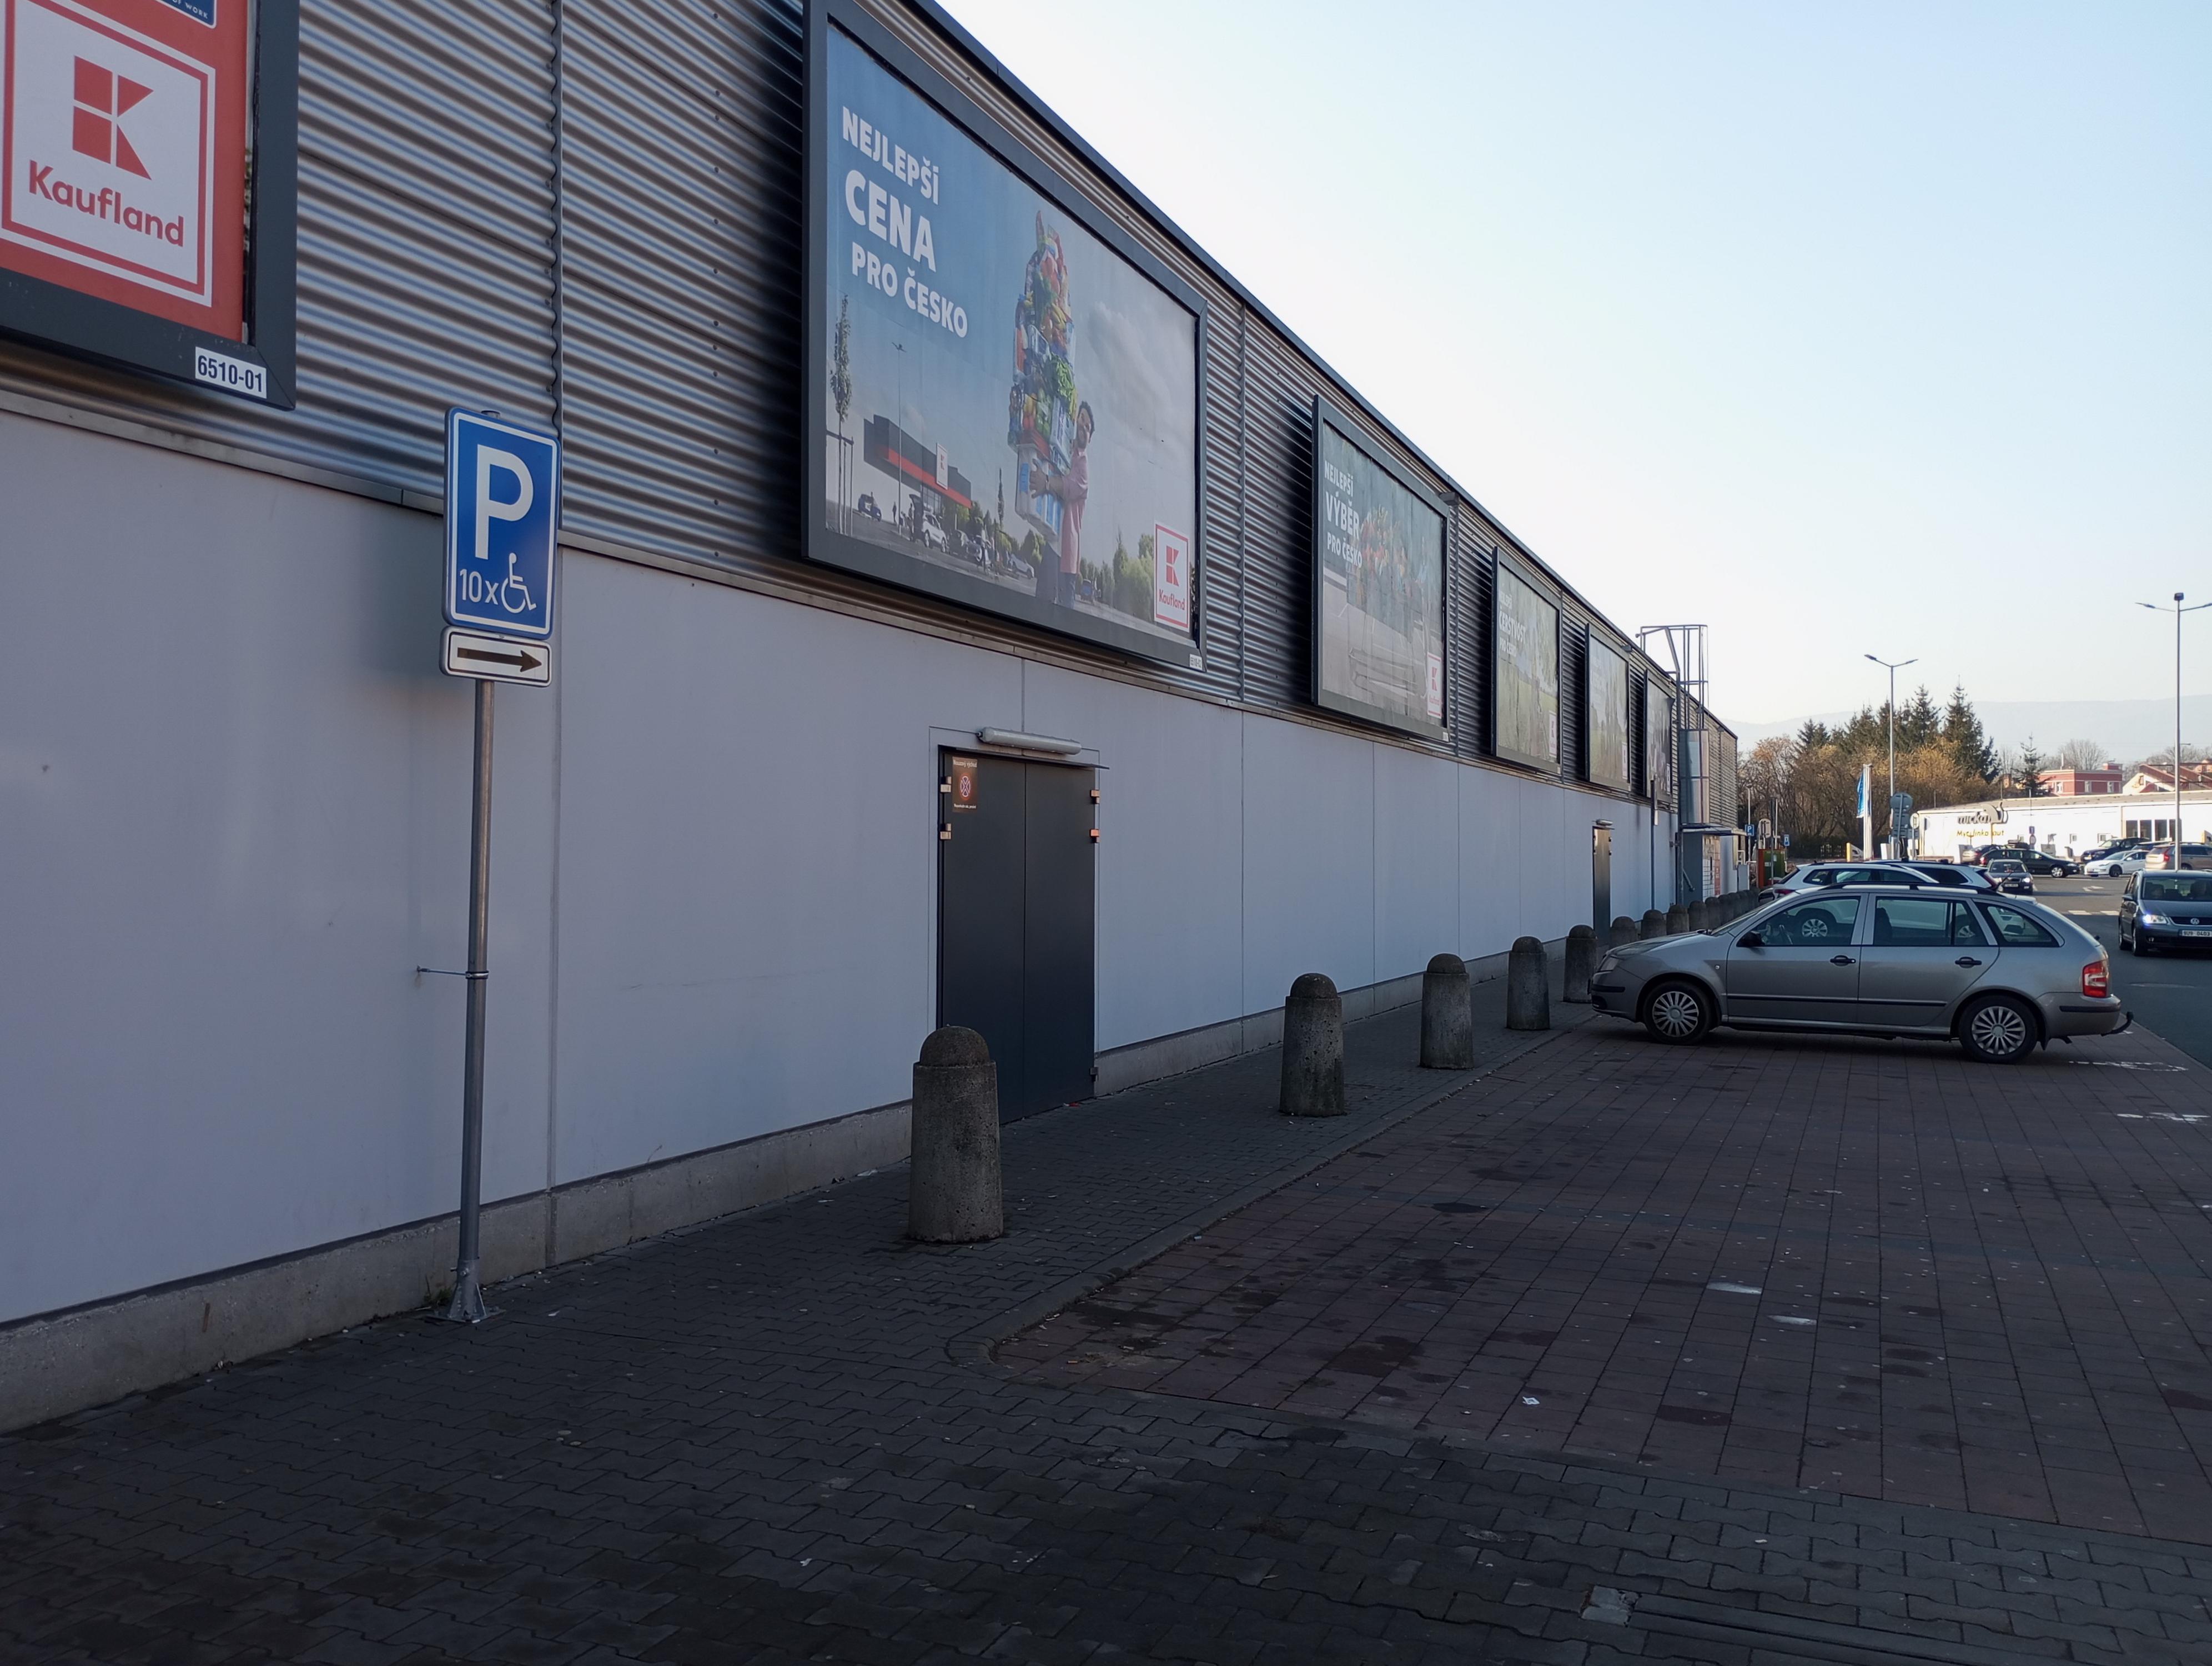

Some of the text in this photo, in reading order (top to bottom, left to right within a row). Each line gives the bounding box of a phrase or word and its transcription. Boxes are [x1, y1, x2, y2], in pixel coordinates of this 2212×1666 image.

[185, 2, 208, 19] WORK
[843, 106, 939, 205] NEJLEPŠÍ
[29, 159, 184, 247] Kaufland
[845, 170, 936, 272] CENA
[852, 242, 968, 338] PRO ČESKO
[198, 354, 263, 393] 6510-01
[475, 444, 534, 560] P
[1324, 460, 1353, 497] NEJLEPŠÍ
[1325, 491, 1360, 540] VÝBĚR
[1327, 532, 1363, 568] PRO ČESKO
[1159, 589, 1185, 610] Kaufland
